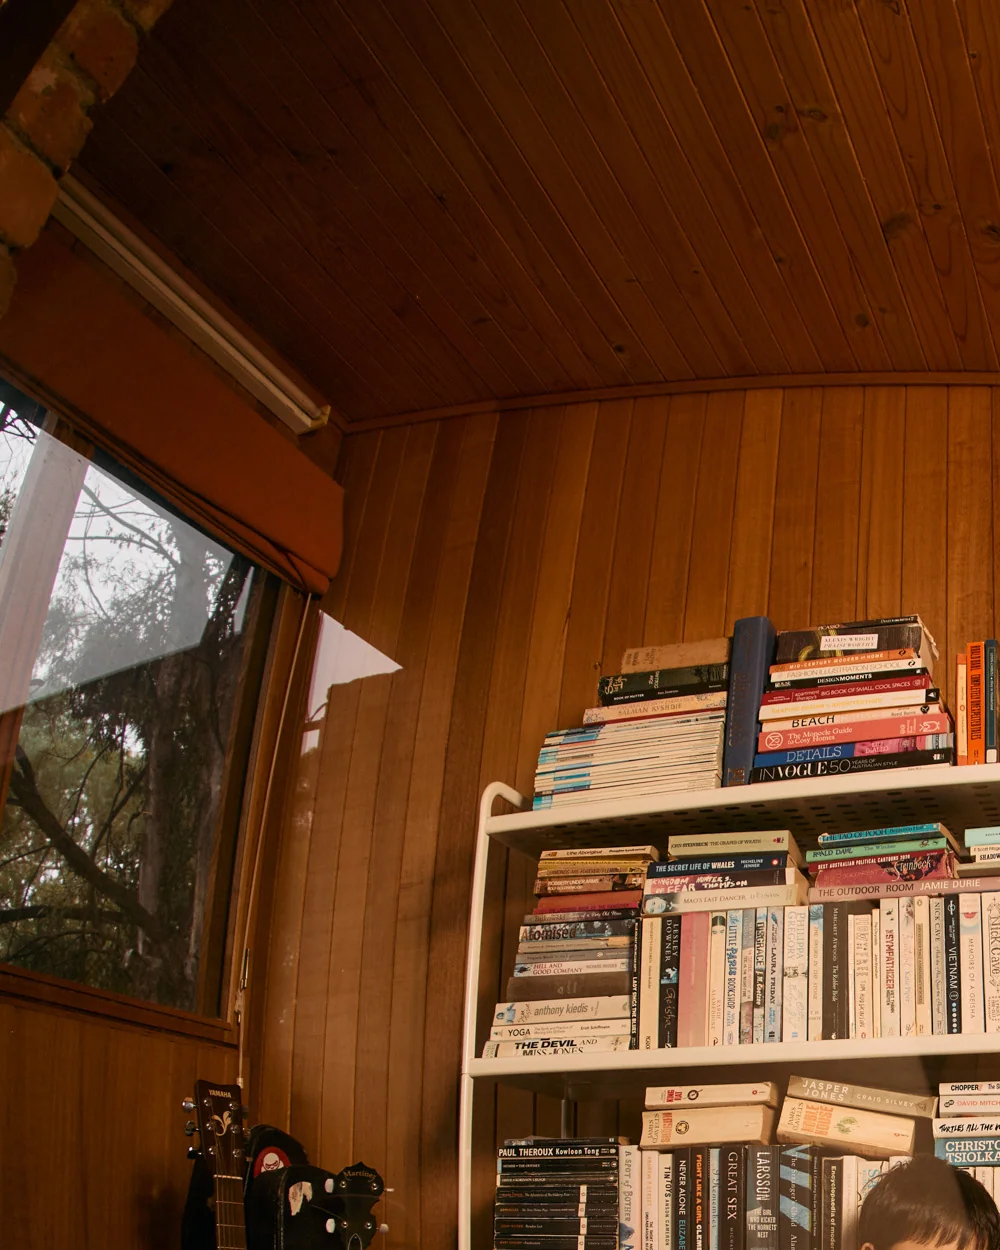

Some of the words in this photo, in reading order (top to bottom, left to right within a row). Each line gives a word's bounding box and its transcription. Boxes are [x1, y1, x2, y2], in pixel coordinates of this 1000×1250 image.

[787, 669, 818, 679] FASHION
[818, 665, 859, 676] ILLUSTRATION
[861, 661, 901, 672] SCHOOL
[792, 715, 835, 727] BEACH
[786, 746, 842, 762] DETAILS
[760, 764, 775, 780] IN
[777, 761, 829, 778] VOGUE
[829, 758, 851, 774] 50
[711, 861, 735, 869] WHALES
[667, 883, 695, 893] FEAR
[818, 889, 835, 897] THE
[836, 886, 880, 895] OUTDOOR
[886, 883, 914, 893] ROOM
[919, 881, 949, 891] JAMIE
[952, 878, 981, 889] DURIE
[520, 926, 577, 940] Atomised
[664, 919, 673, 962] DOWNER
[672, 922, 680, 957] LESLEY
[796, 912, 806, 960] PHILIPPA
[885, 934, 896, 990] SYMPATHIZER
[948, 946, 958, 989] VIETNAM
[534, 1004, 565, 1017] anthony
[565, 1002, 588, 1014] kiedis
[508, 1029, 531, 1037] YOGA
[515, 1041, 540, 1049] THE
[540, 1038, 578, 1049] DEVIL
[208, 1089, 232, 1099] YAMAHA
[802, 1080, 849, 1095] JASPER
[804, 1090, 846, 1102] JONES
[498, 1148, 517, 1157] PAUL
[519, 1147, 554, 1156] THEROUX
[555, 1147, 582, 1155] Kowloon
[584, 1147, 600, 1156] Tong
[678, 1160, 687, 1186] NEVER
[695, 1154, 703, 1179] FIGHT
[728, 1151, 738, 1194] GREAT
[756, 1152, 771, 1201] LARSSON
[695, 1179, 703, 1200] LIKE
[678, 1186, 687, 1216] ALONE
[727, 1197, 738, 1220] SEX
[695, 1206, 703, 1224] GIRL
